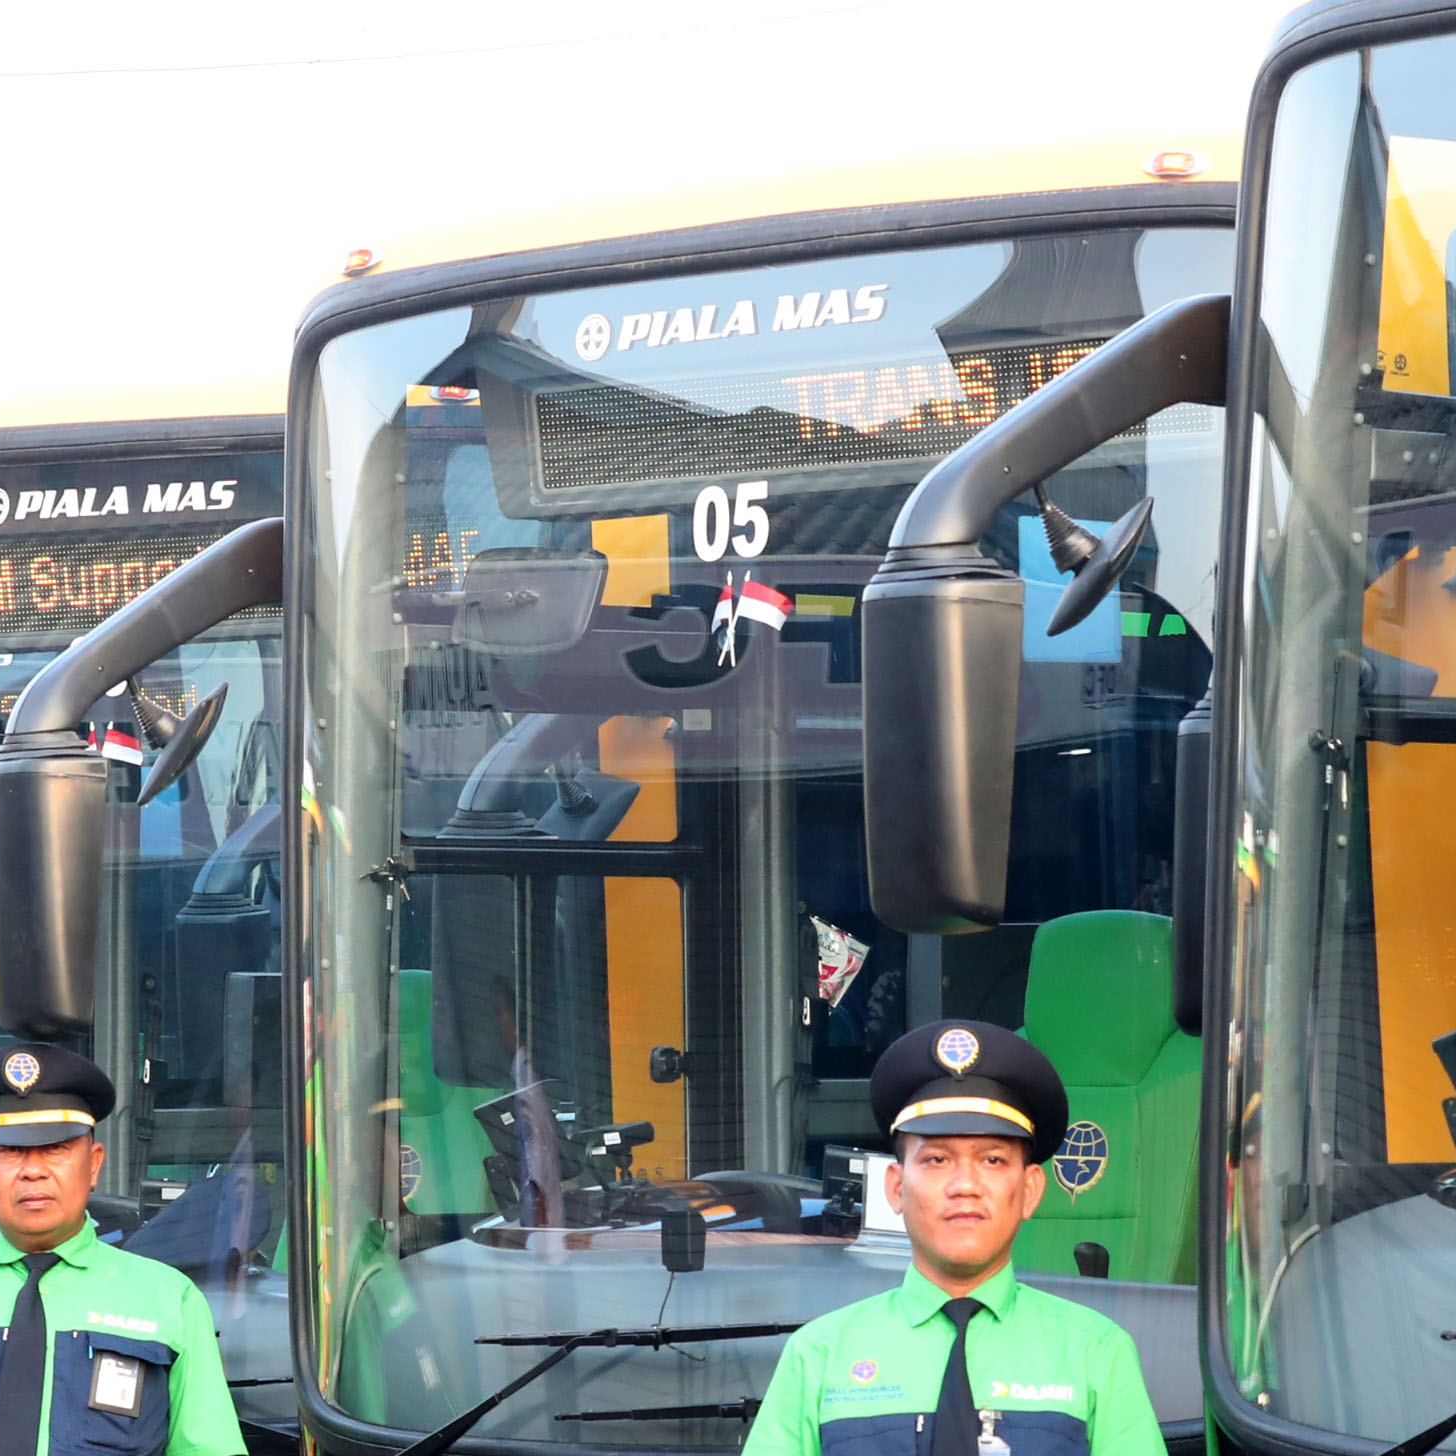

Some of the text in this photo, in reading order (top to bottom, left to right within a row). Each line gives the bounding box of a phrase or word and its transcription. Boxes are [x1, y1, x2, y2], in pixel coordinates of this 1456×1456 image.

[616, 283, 889, 351] PIALA MAS
[781, 357, 996, 438] TRANS
[14, 479, 239, 521] PIALA MAS
[691, 480, 770, 562] 05
[1010, 1382, 1073, 1401] DAMRI
